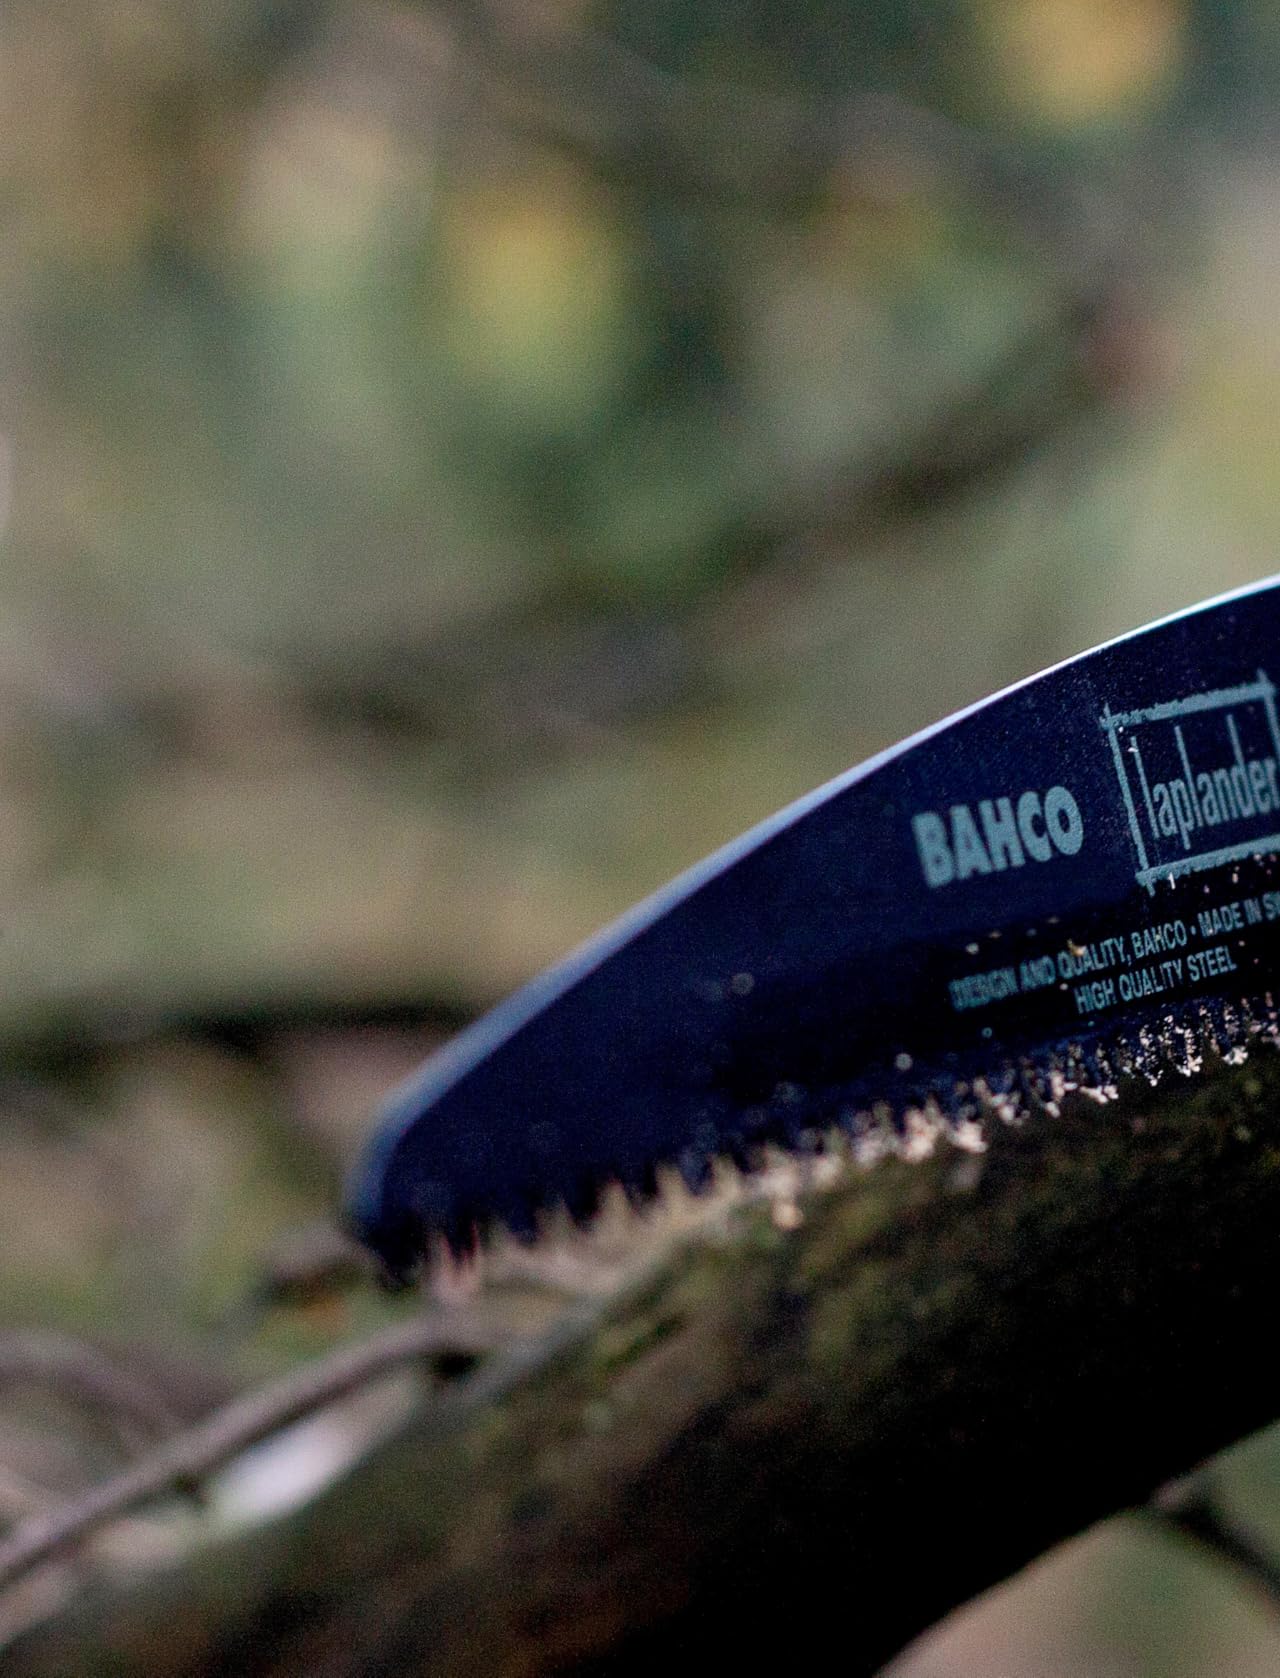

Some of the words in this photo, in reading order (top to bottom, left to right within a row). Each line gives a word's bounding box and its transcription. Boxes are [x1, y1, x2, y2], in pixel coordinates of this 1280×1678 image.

[912, 786, 1084, 889] BAHCO
[1019, 955, 1056, 990] AND
[1132, 919, 1188, 959] BAHCO
[1198, 903, 1245, 938] MADE
[1245, 898, 1263, 926] IN
[1073, 982, 1118, 1015] HIGH
[1118, 958, 1185, 1001] QUALITY
[1187, 945, 1238, 982] STEEL
